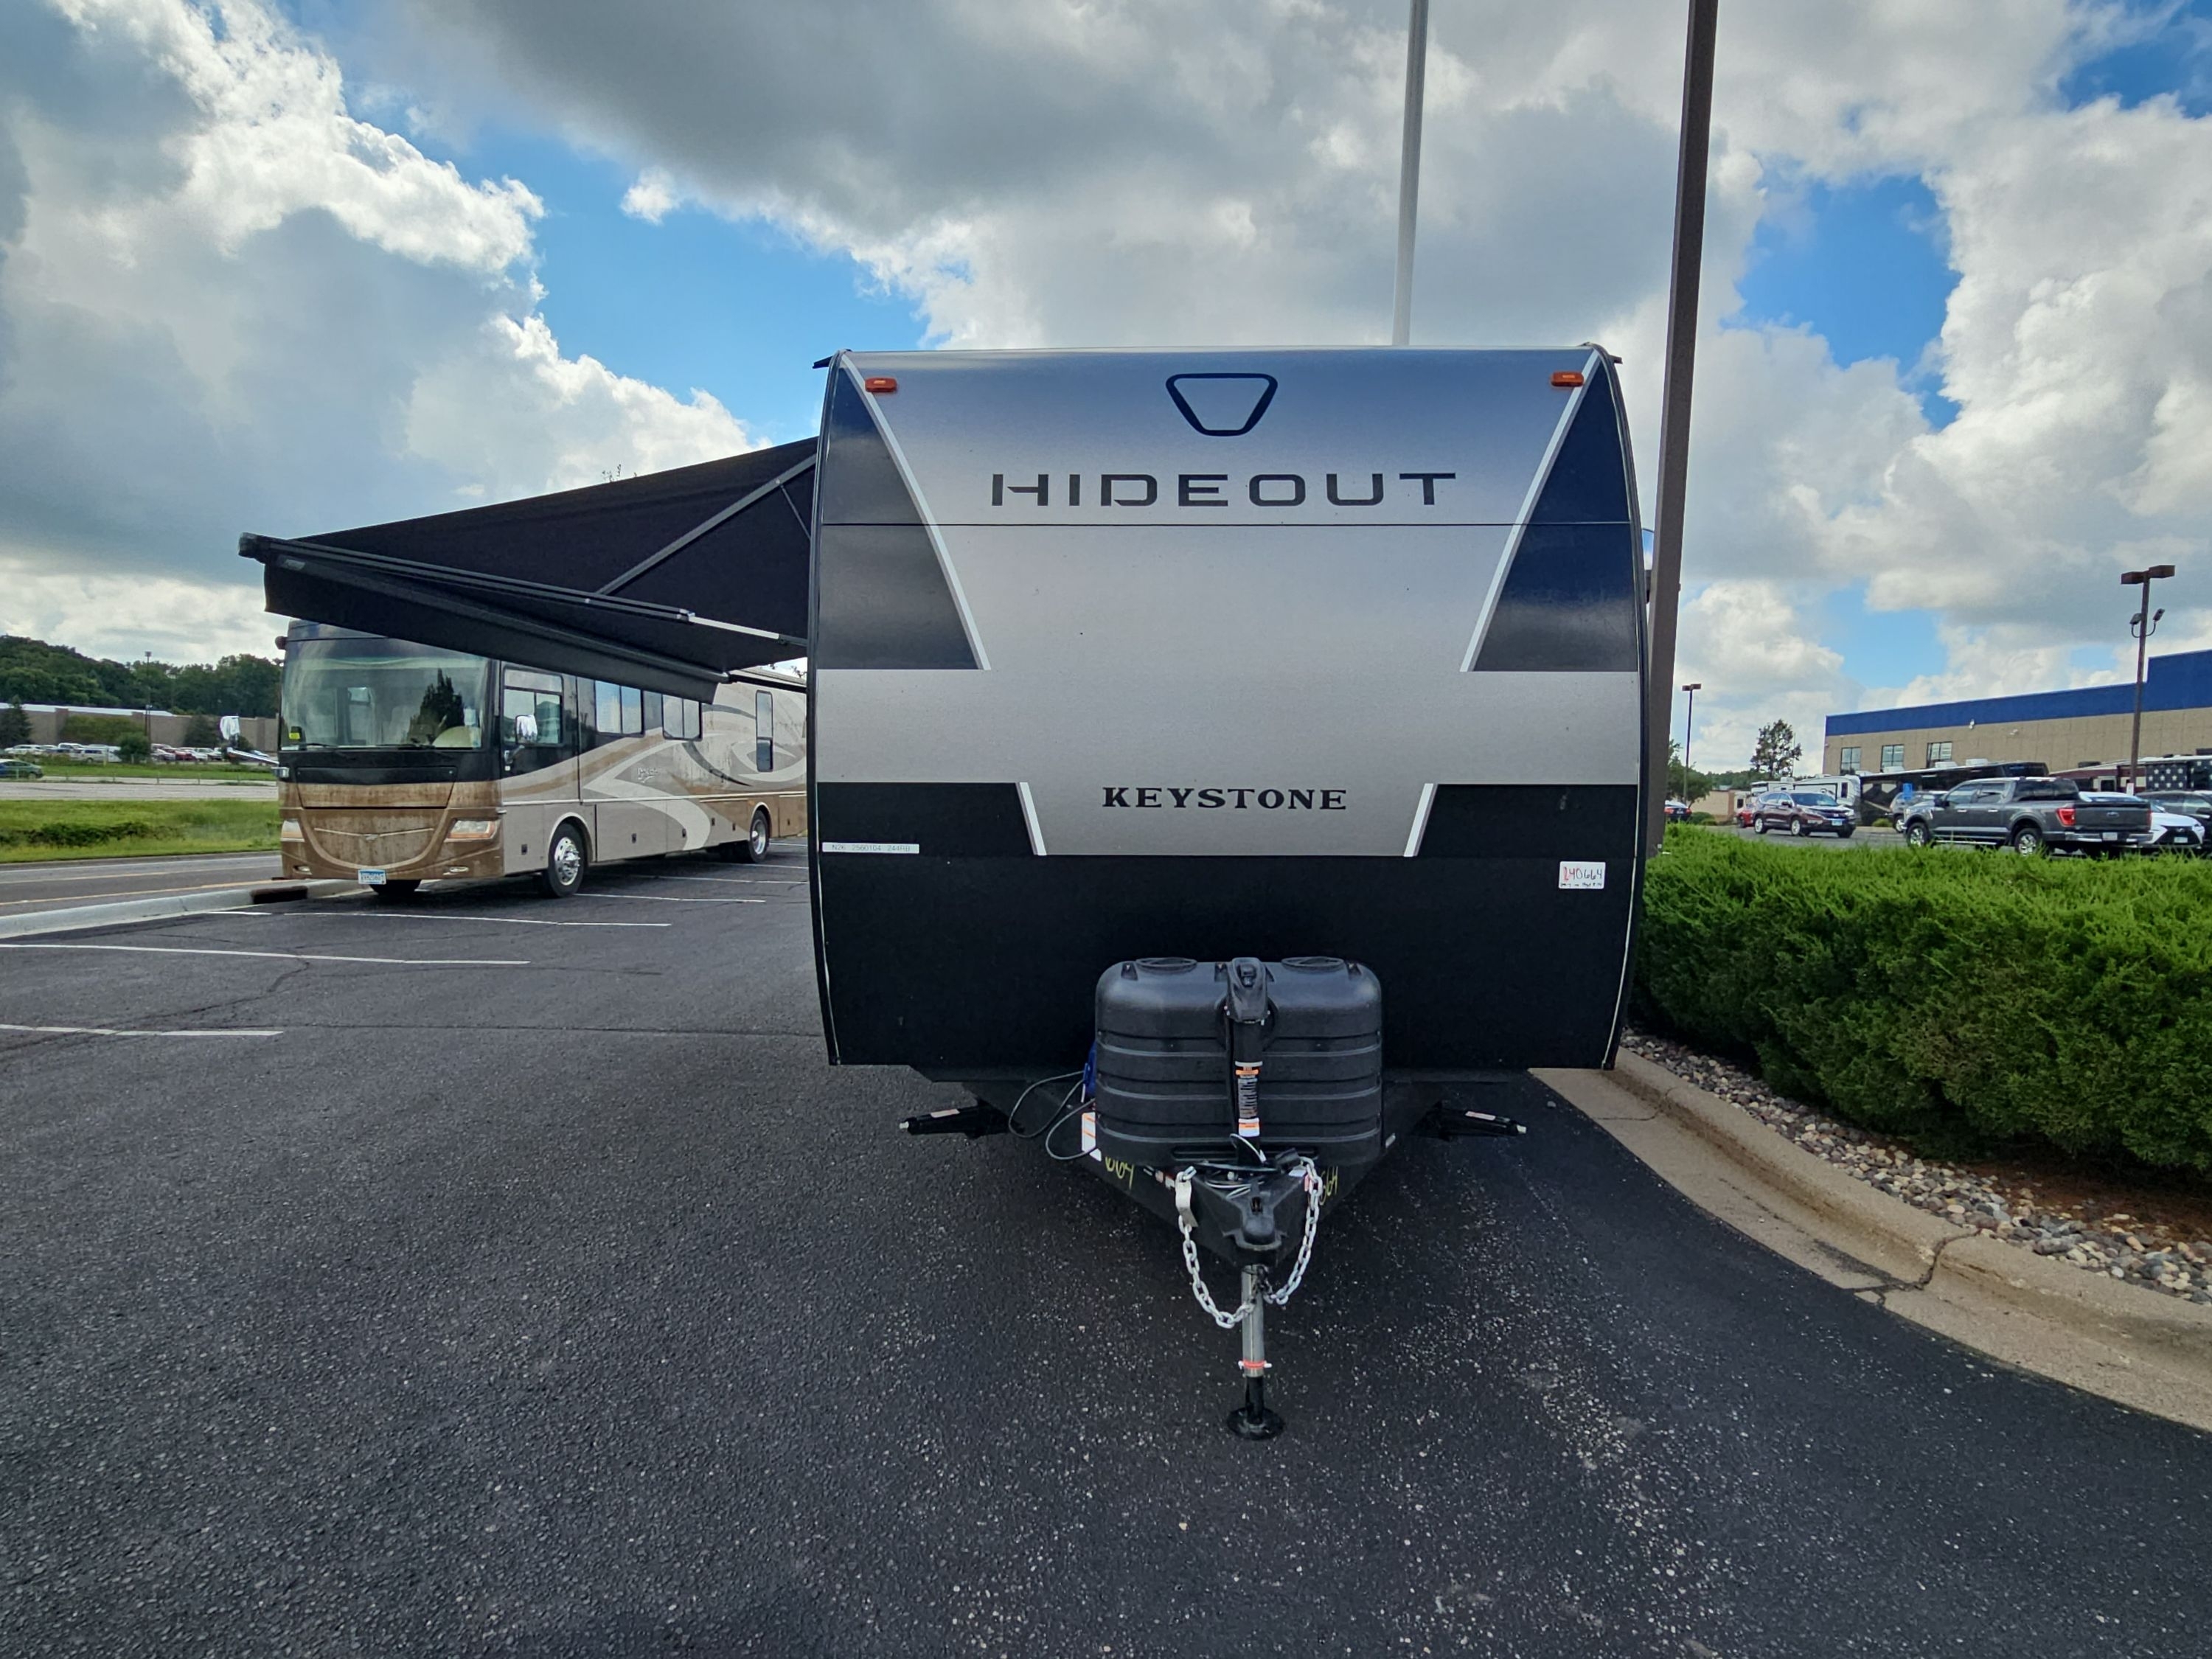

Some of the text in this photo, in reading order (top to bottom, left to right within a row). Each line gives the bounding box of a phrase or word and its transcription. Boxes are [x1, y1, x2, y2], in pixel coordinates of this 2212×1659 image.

[992, 473, 1456, 507] HIDEOUT
[1102, 787, 1347, 810] KEYSTONE
[1105, 1155, 1135, 1189] 664
